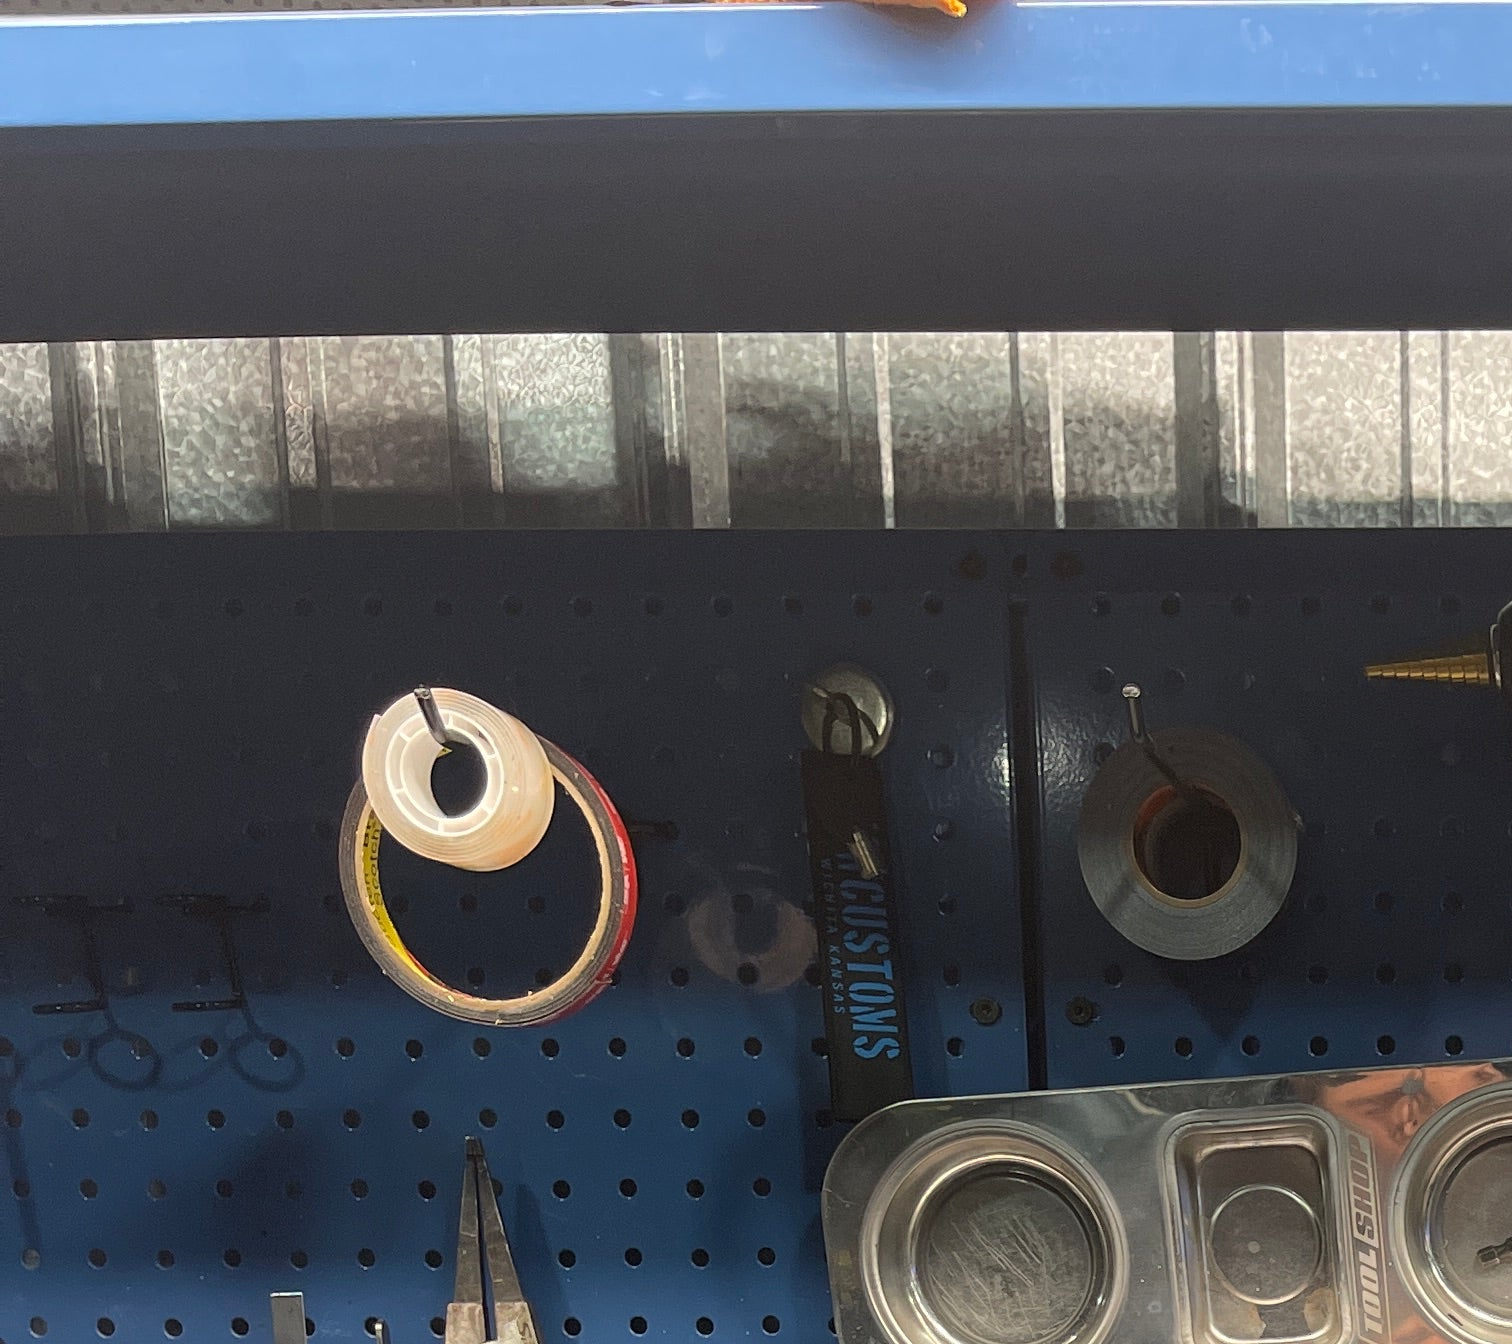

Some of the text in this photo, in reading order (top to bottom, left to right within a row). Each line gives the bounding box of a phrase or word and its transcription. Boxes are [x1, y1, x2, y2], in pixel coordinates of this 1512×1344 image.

[830, 944, 845, 1015] KANSAS
[1349, 1132, 1384, 1336] TOOL SHOP
